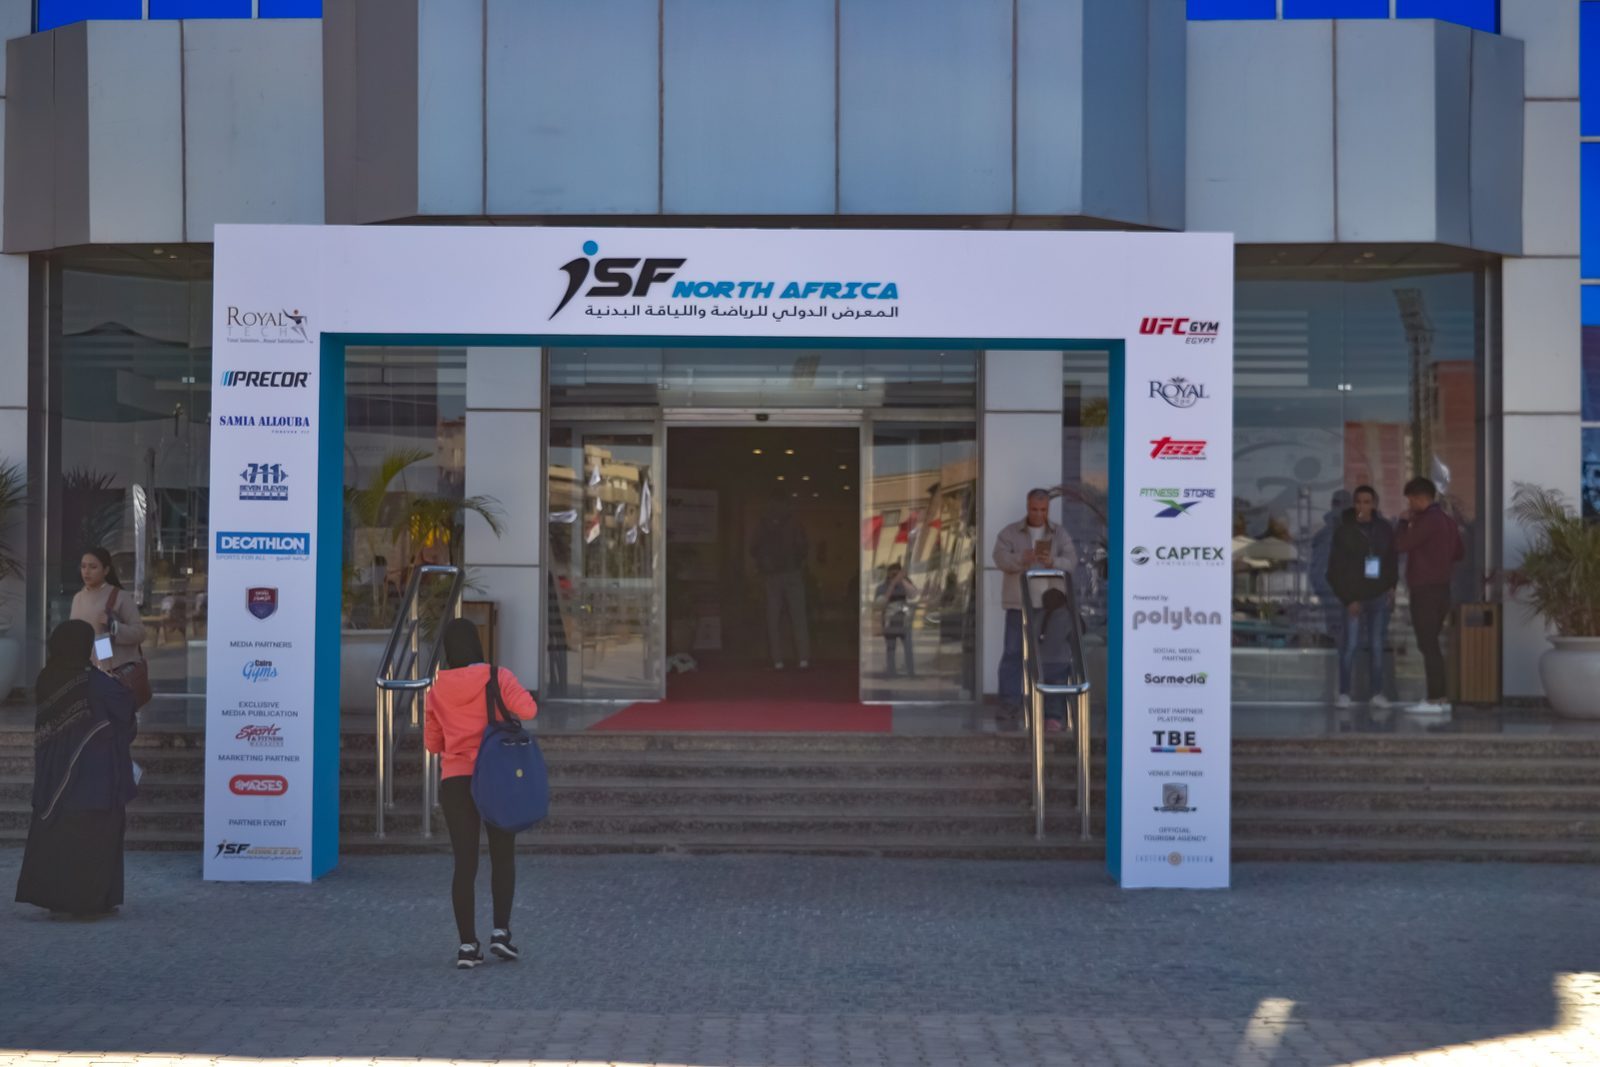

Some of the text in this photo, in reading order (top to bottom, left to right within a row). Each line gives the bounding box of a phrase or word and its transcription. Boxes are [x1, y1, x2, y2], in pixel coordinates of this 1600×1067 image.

[672, 280, 898, 299] NORTH AFRICA
[585, 305, 898, 322] المعرض الدولي للرياضة واللياقة البدنية
[227, 327, 288, 336] TECH
[1139, 317, 1219, 335] UFC GYM
[233, 371, 308, 387] PRECOR
[220, 415, 310, 427] SAMIA ALLOUBA
[248, 464, 281, 483] 711
[1140, 488, 1215, 498] FITNESS STORE
[221, 536, 305, 550] DECATHLON
[1155, 547, 1224, 560] CAPTEX
[1132, 606, 1221, 630] polytan
[242, 661, 278, 683] Gyms
[1144, 673, 1206, 684] Sarmedia
[235, 723, 281, 741] Sports
[1152, 731, 1196, 746] TBE
